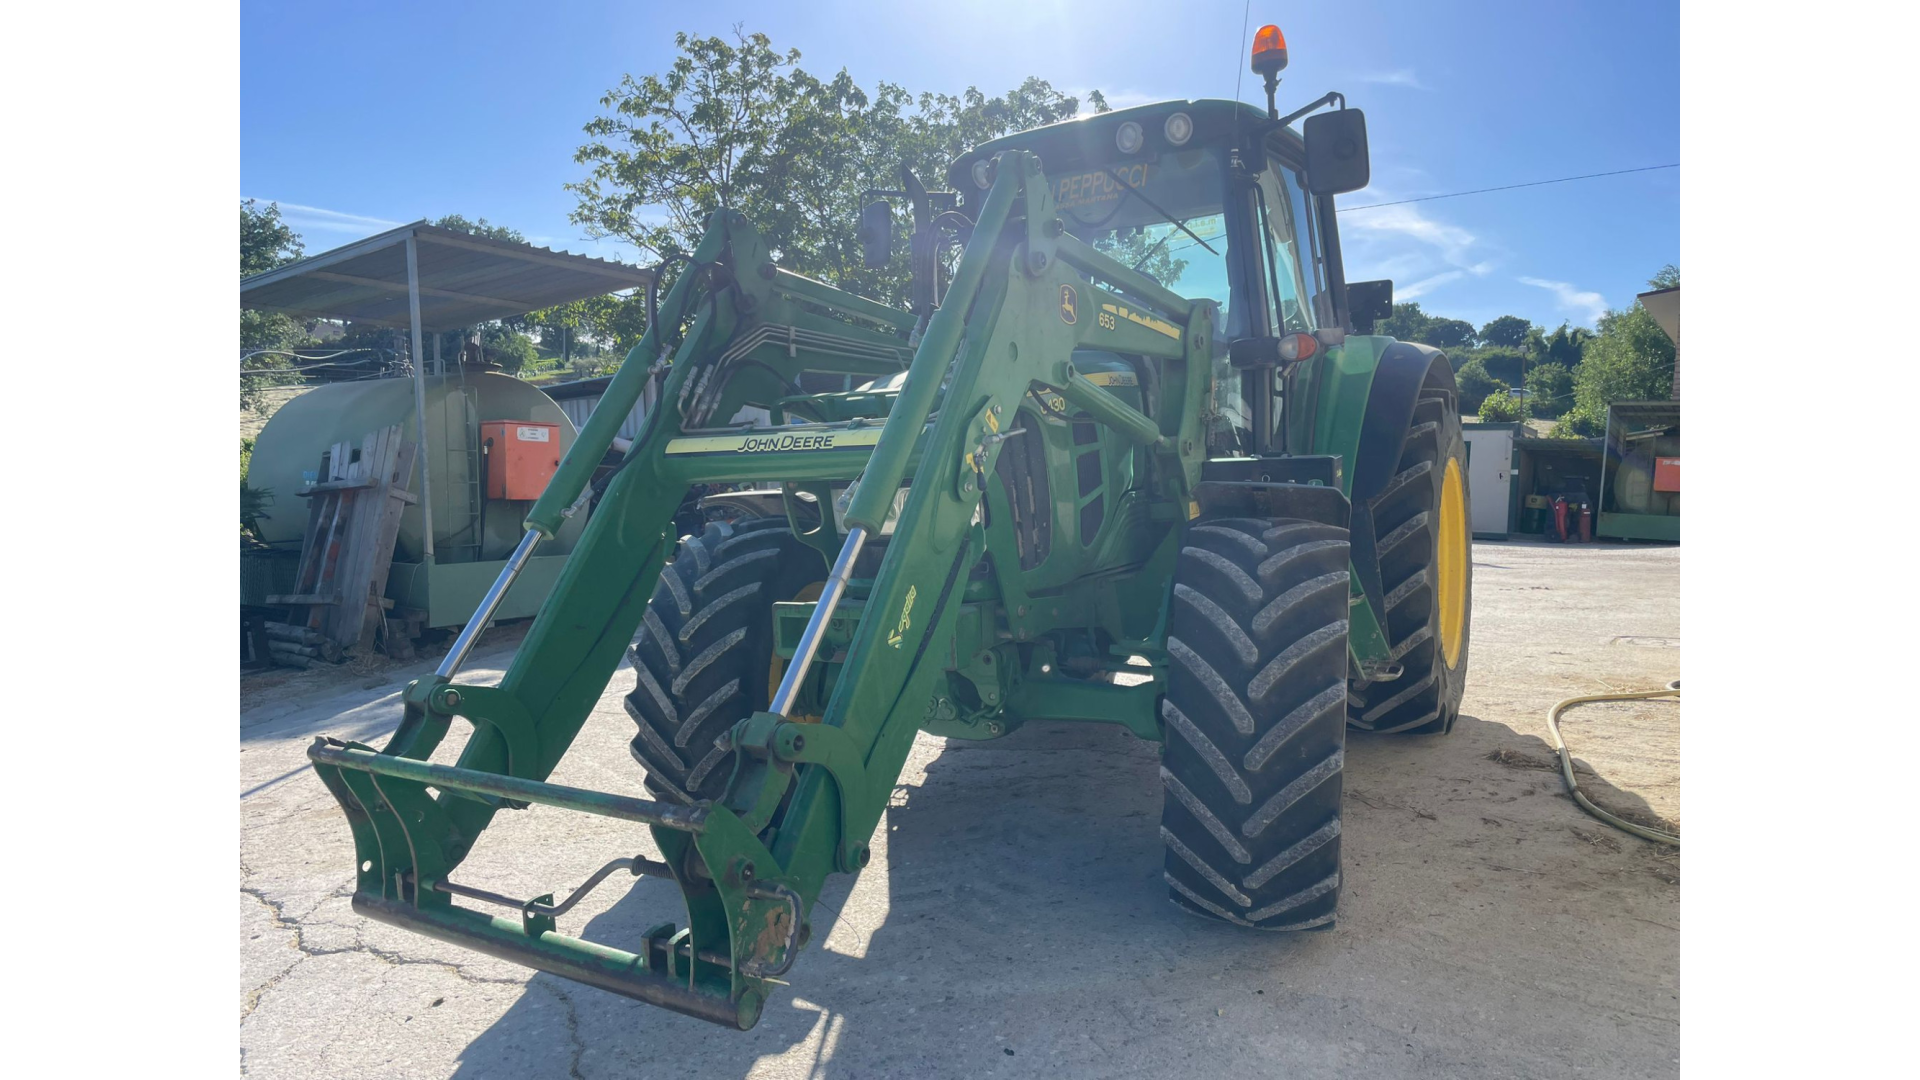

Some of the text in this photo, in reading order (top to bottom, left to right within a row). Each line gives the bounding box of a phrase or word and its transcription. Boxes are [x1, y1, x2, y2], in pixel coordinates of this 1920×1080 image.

[1058, 163, 1148, 202] PEPPUCCI
[1099, 312, 1115, 331] 653
[737, 435, 836, 452] JOHN DEERE
